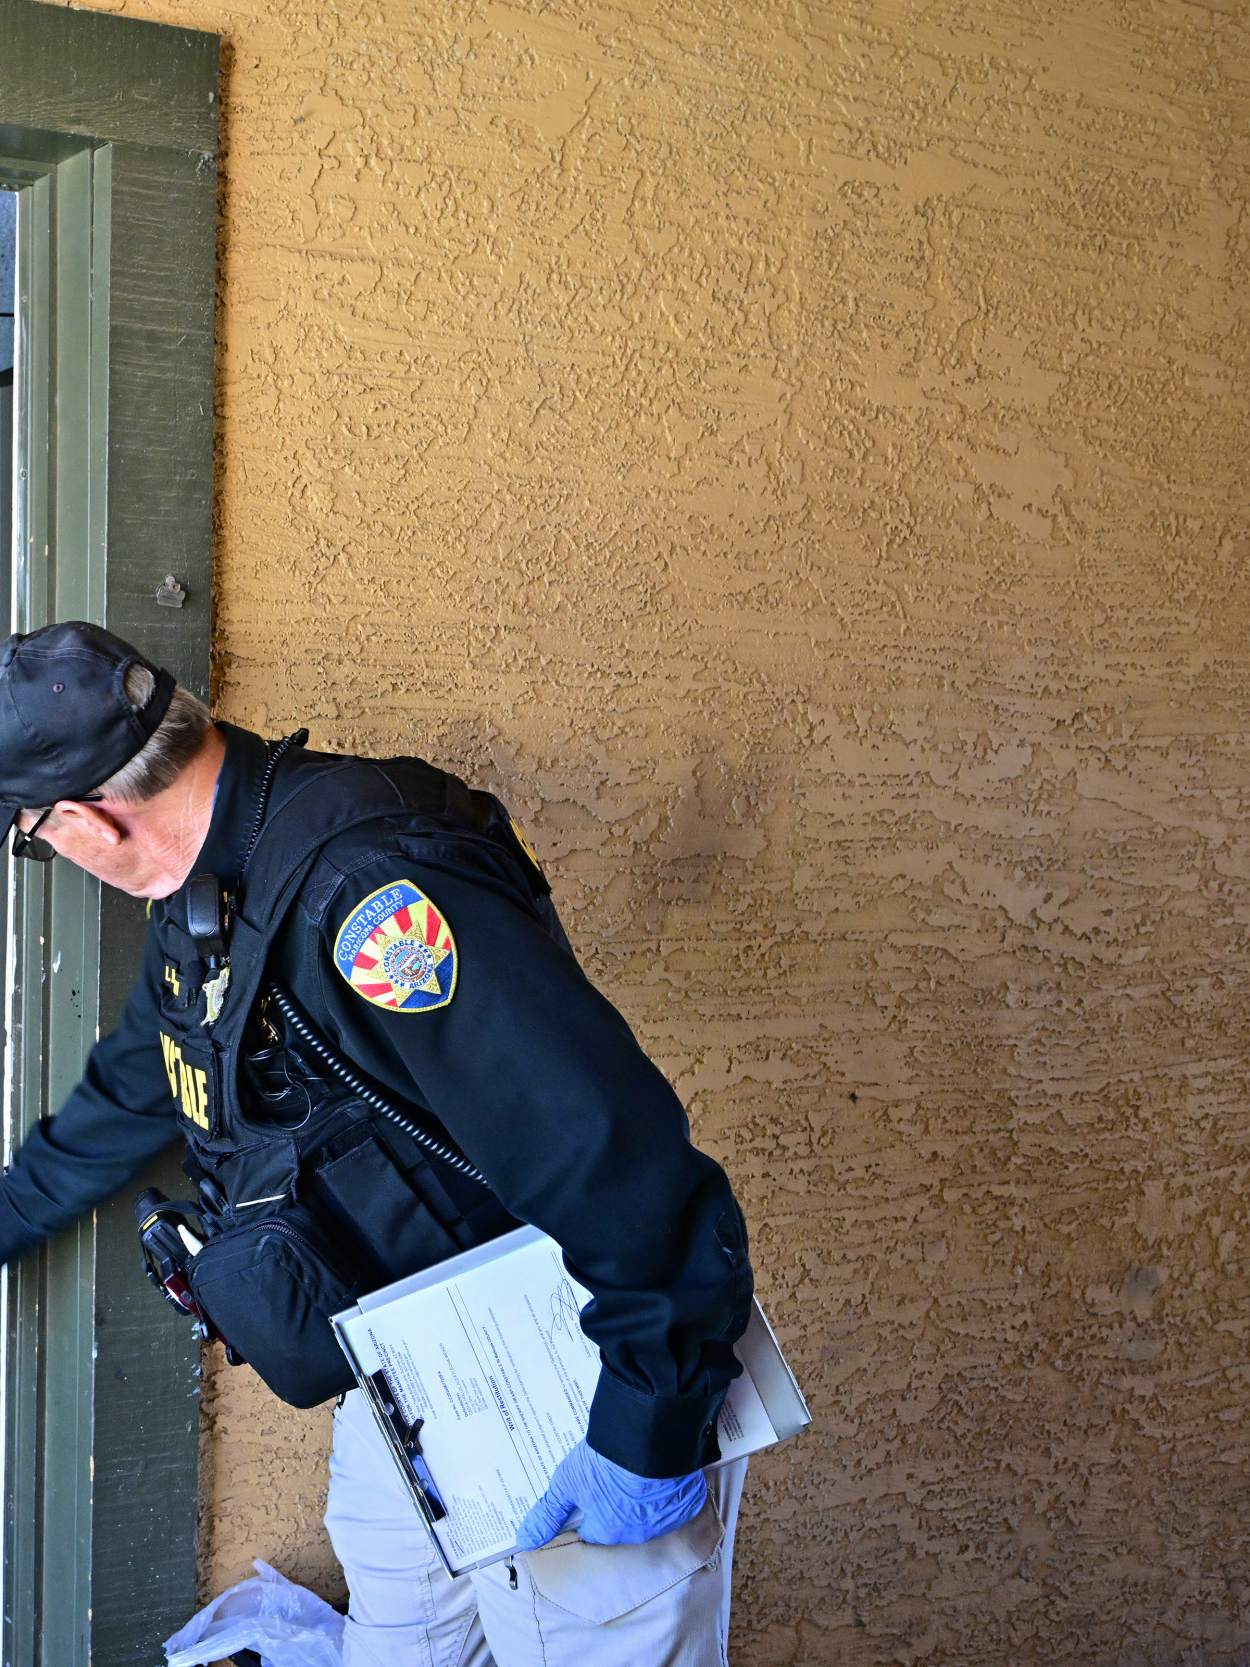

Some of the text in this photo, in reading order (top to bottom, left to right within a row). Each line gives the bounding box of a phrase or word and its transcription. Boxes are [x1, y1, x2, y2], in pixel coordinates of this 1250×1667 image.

[338, 888, 403, 961] CONSTABLE
[348, 900, 404, 962] MARICOPA COUNTY
[383, 939, 415, 973] CONSTABLE
[409, 963, 434, 989] ARIZONA
[487, 1374, 515, 1431] Writ of Restitution
